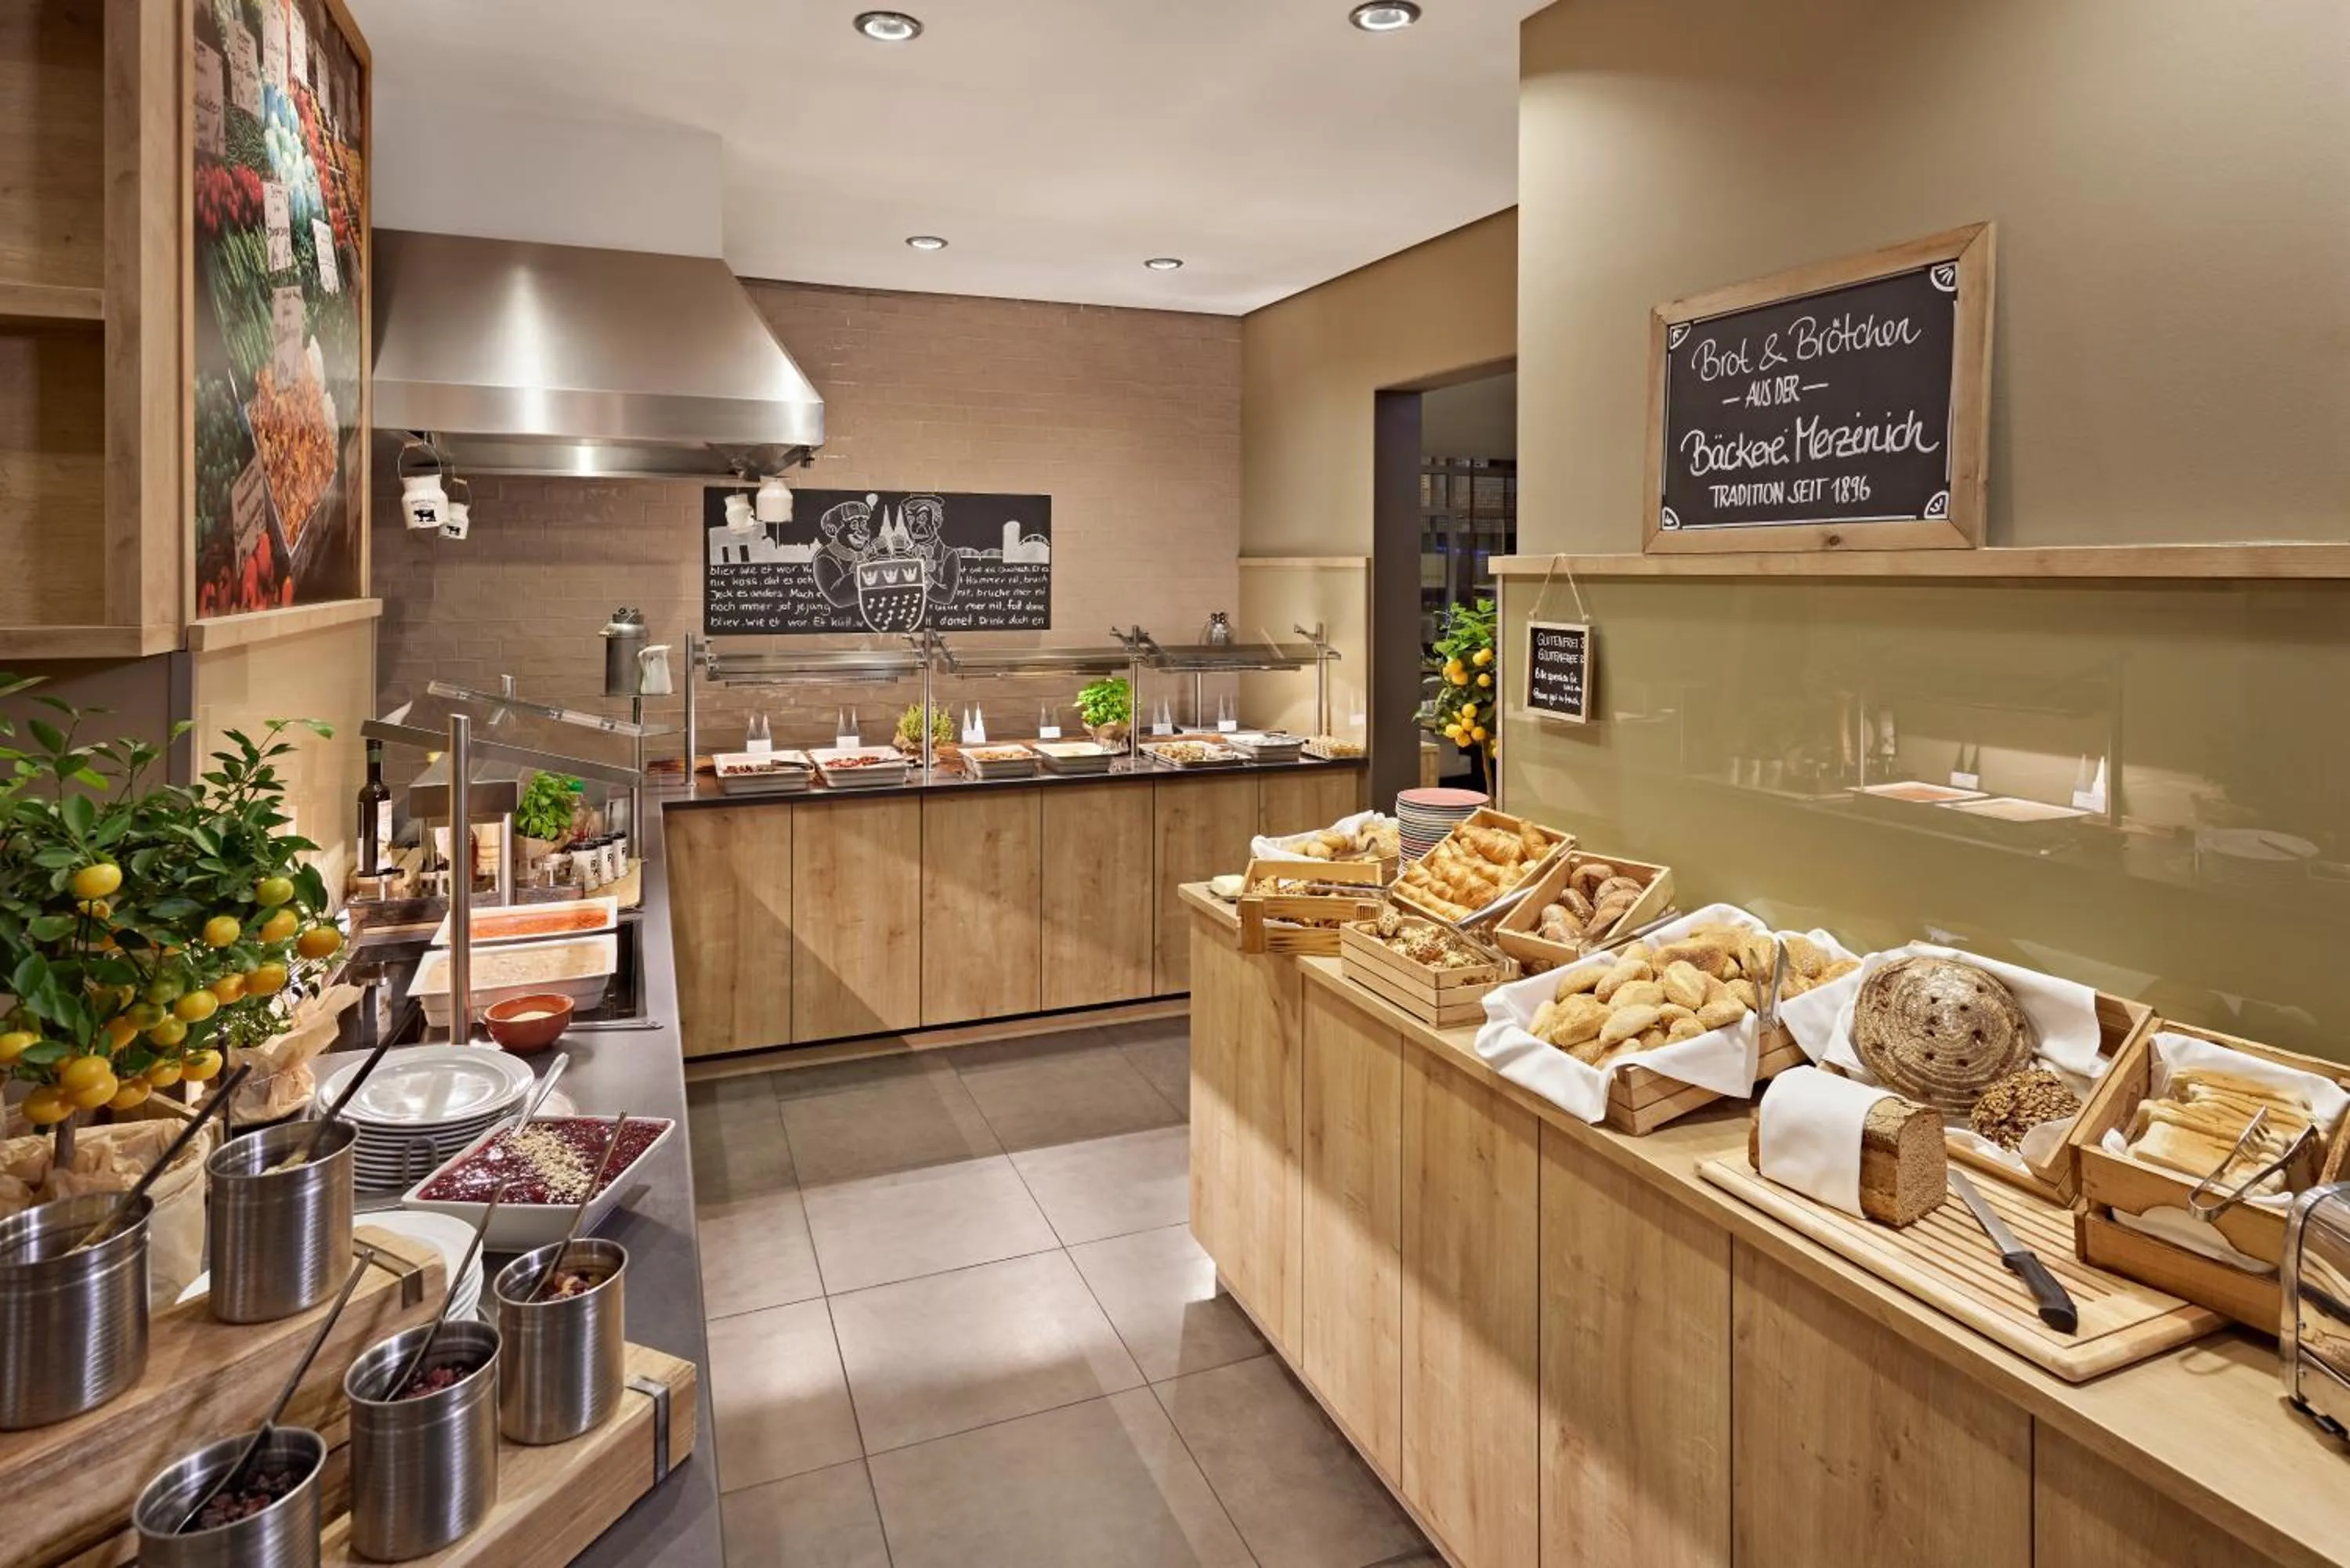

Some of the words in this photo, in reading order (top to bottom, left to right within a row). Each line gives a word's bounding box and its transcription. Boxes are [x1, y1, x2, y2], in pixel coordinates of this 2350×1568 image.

[1692, 338, 1754, 381] Brot
[1759, 333, 1788, 370] &
[1788, 313, 1922, 360] Brötchen
[1744, 379, 1771, 408] AUS
[1774, 374, 1800, 405] DER
[1708, 480, 1784, 508] TRADITION
[1788, 478, 1830, 504] SEIT
[1831, 474, 1871, 504] 1896
[710, 602, 736, 612] noch
